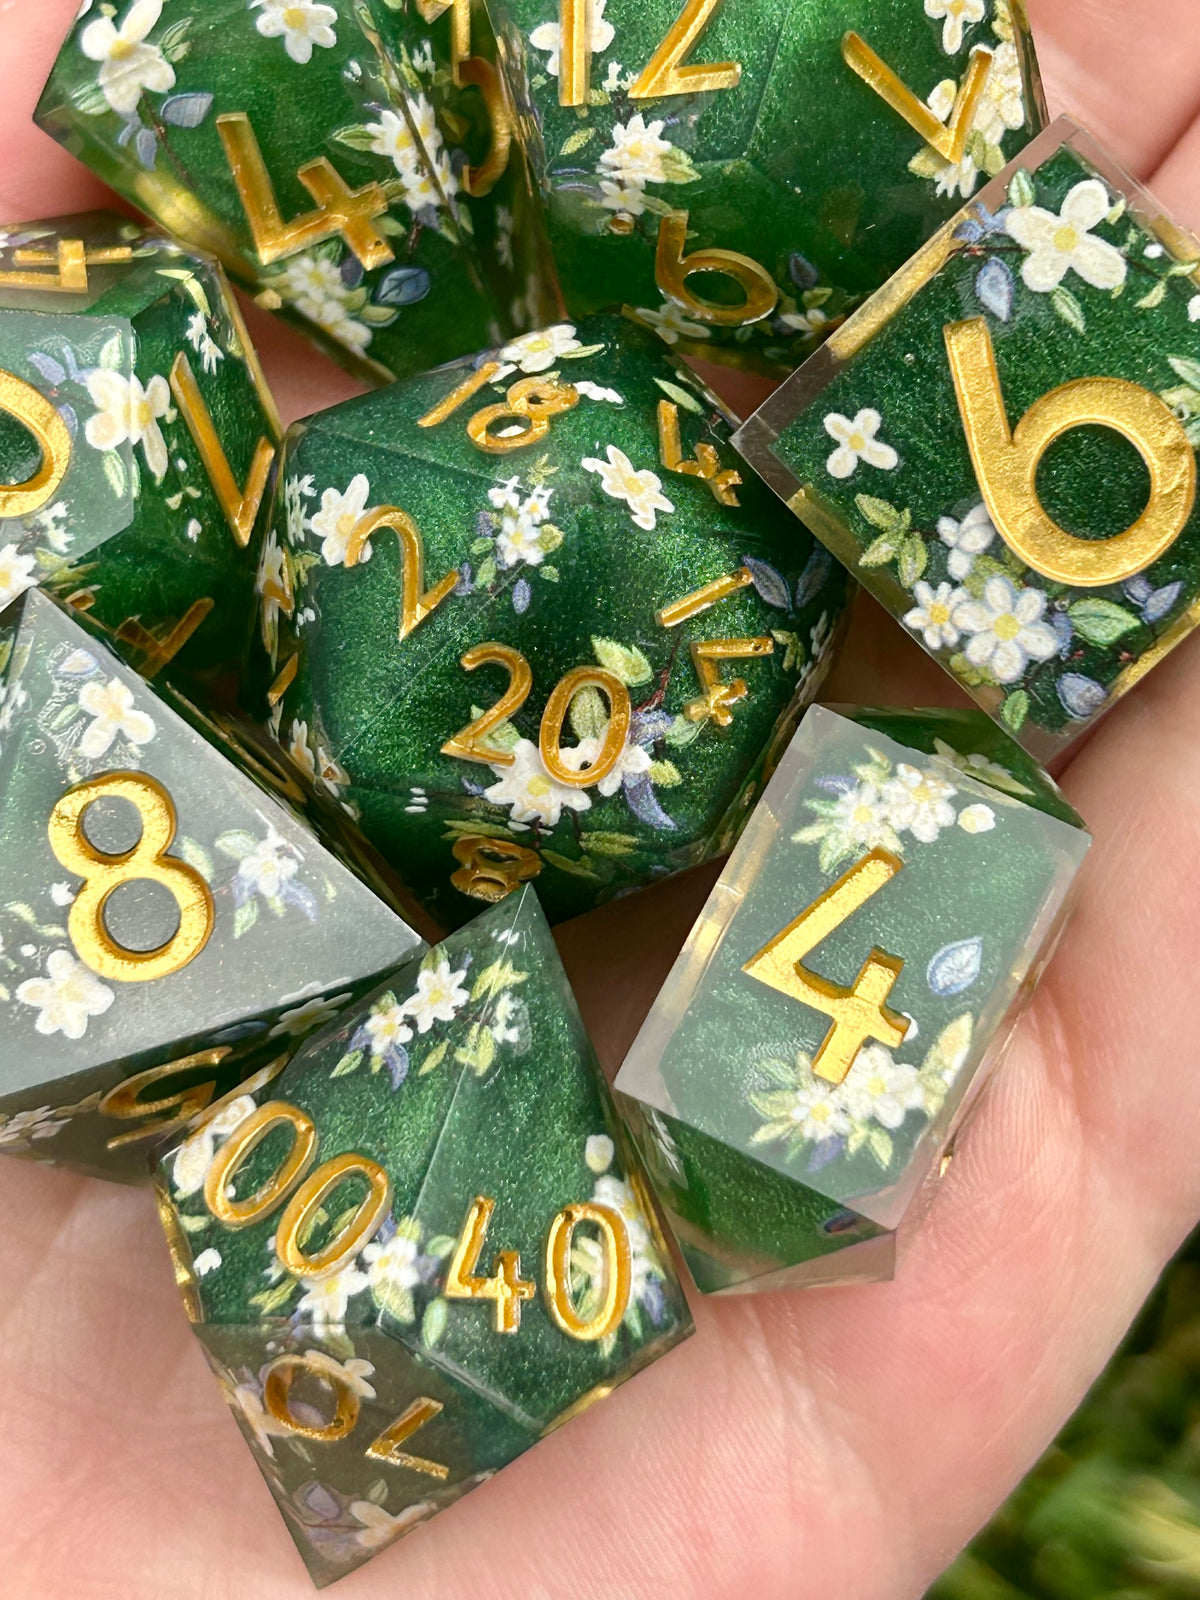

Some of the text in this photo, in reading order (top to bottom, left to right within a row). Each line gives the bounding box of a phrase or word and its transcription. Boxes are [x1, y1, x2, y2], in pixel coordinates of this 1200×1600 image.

[216, 111, 397, 272] 4
[417, 361, 581, 455] 18
[657, 398, 744, 507] 4
[942, 315, 1197, 588] 6
[344, 503, 460, 641] 2
[655, 564, 775, 728] 14
[439, 641, 632, 789] 20
[47, 768, 216, 983] 8
[741, 846, 912, 1086] 4
[203, 1099, 392, 1280] 00
[444, 1194, 633, 1342] 40
[264, 1352, 450, 1481] 70
